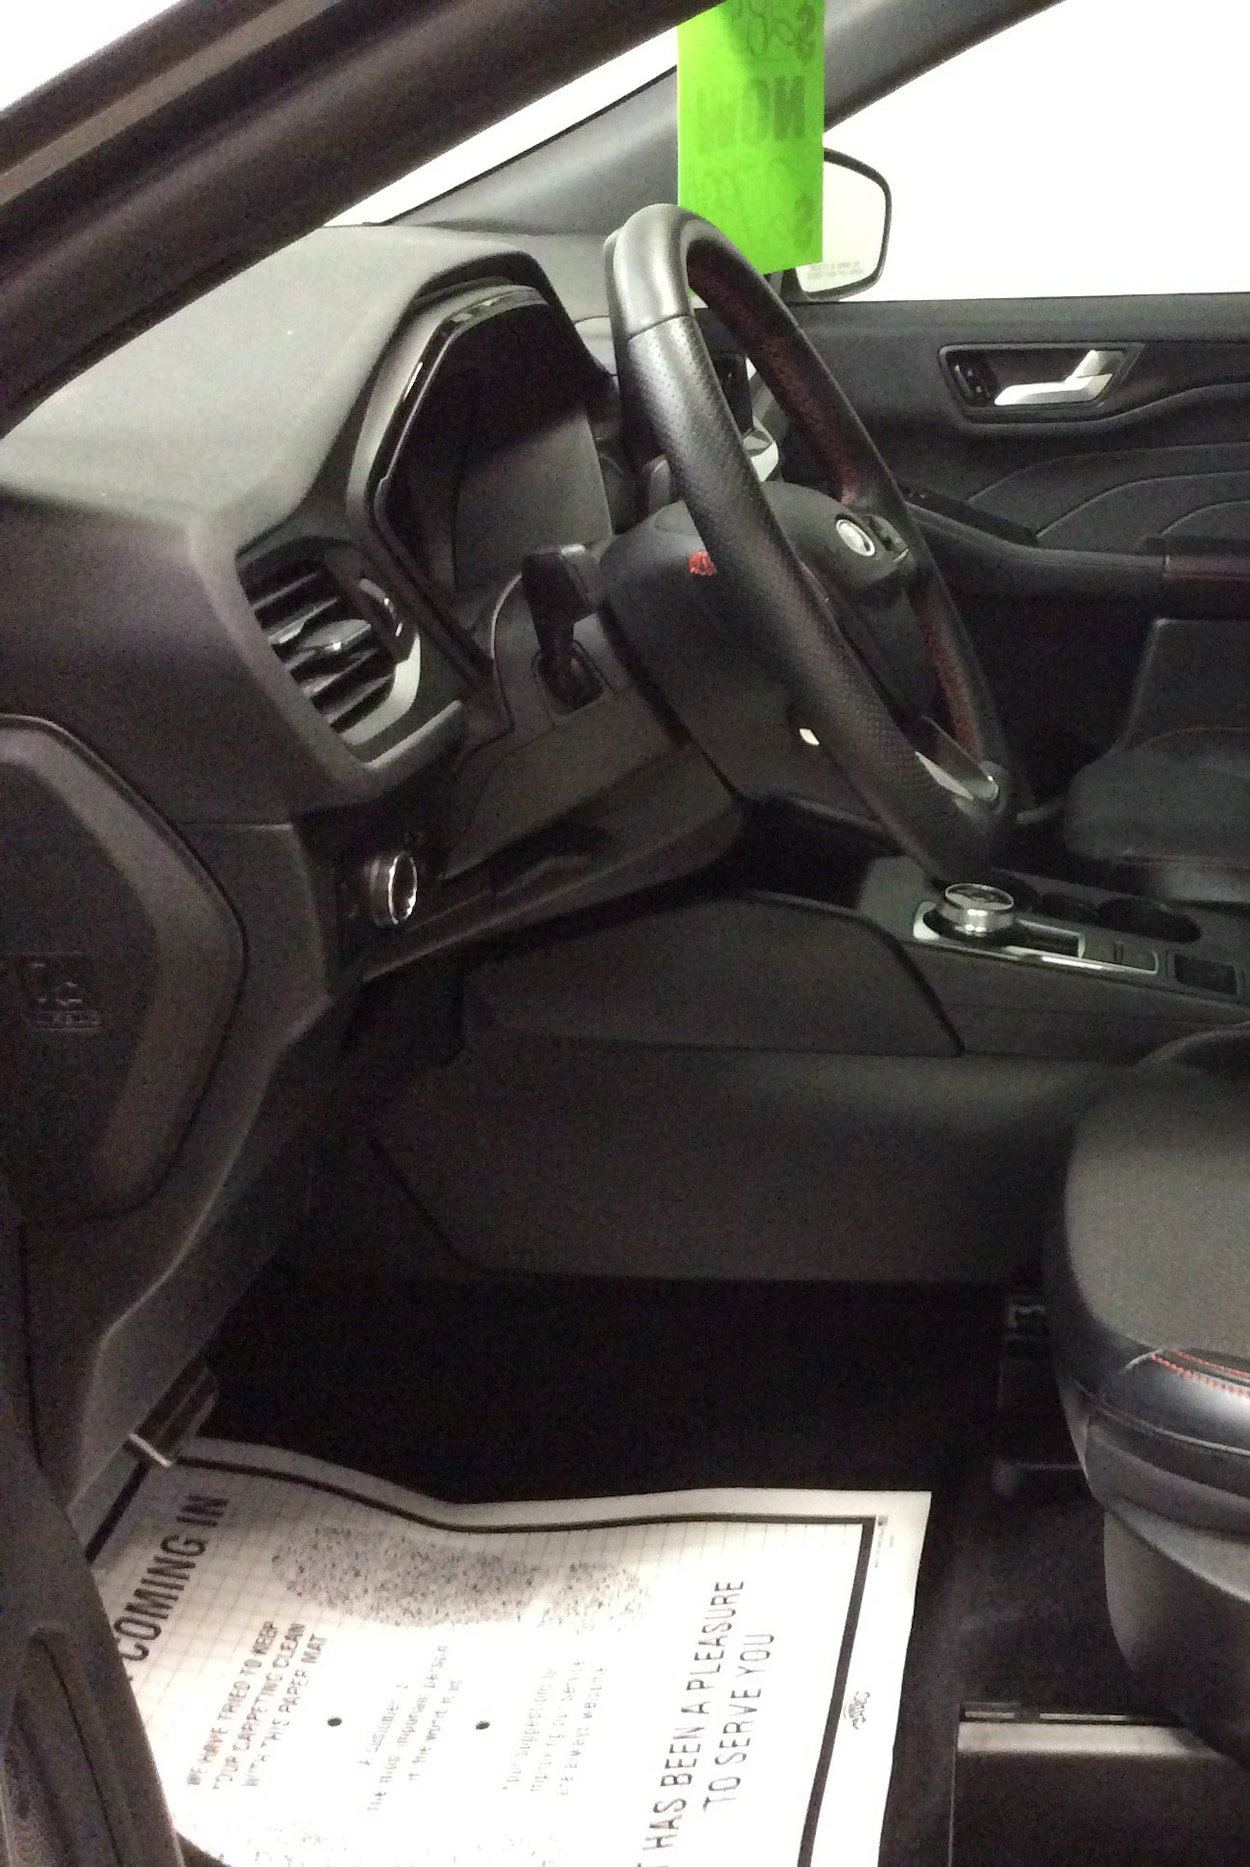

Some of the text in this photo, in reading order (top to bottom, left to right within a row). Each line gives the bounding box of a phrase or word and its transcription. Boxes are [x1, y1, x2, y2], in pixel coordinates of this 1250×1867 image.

[113, 1495, 228, 1662] COMING IN
[250, 1621, 278, 1656] KEEP
[686, 1581, 744, 1691] PLEASURE
[232, 1672, 283, 1750] CARPETING
[272, 1622, 306, 1668] CLEAN
[239, 1658, 262, 1676] TO
[261, 1718, 290, 1748] THIS
[278, 1670, 308, 1713] PAPER
[301, 1633, 326, 1663] MAT
[217, 1681, 250, 1720] TRIED
[680, 1700, 711, 1716] A
[702, 1634, 775, 1813] TO SERVE YOU
[660, 1727, 704, 1787] BEEN
[643, 1798, 687, 1850] HAS
